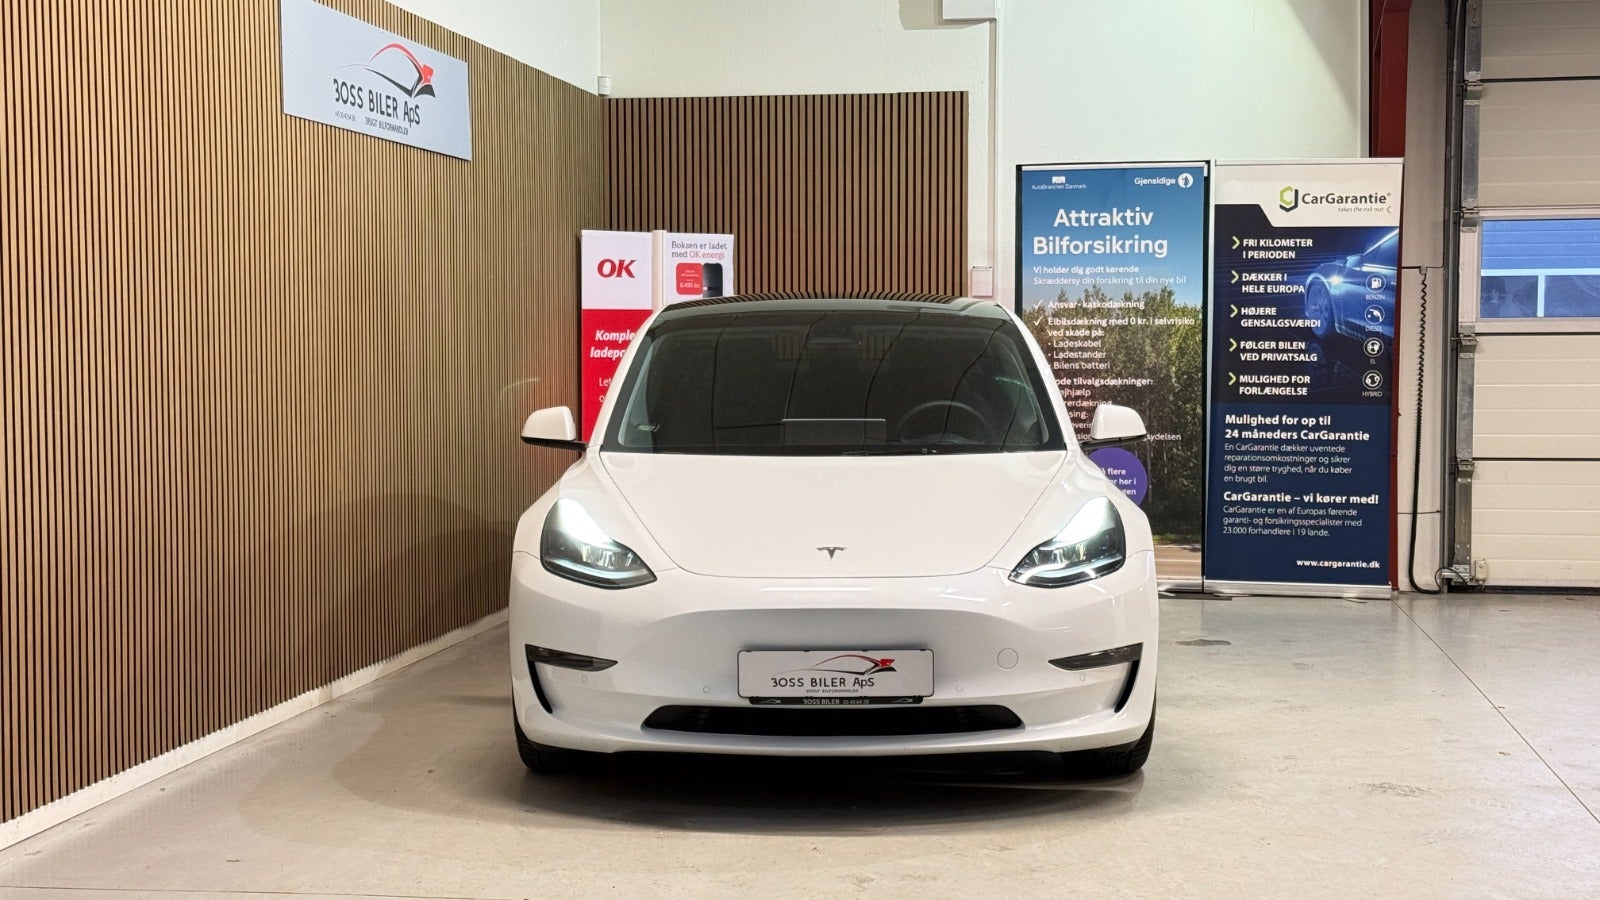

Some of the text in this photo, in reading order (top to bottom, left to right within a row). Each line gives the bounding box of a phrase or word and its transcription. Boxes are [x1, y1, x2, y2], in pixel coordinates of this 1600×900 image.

[368, 89, 399, 119] BILER
[403, 100, 421, 128] ApS
[1134, 176, 1176, 186] Gjensidige
[1053, 206, 1154, 228] Attraktiv
[671, 240, 698, 249] Boksen
[708, 242, 728, 250] ladet
[1033, 234, 1168, 259] Bilforsikring
[1243, 238, 1313, 248] FRI KILOMETER
[702, 251, 725, 261] energi
[1243, 251, 1296, 260] I PERIODEN
[597, 258, 637, 279] OK
[1033, 265, 1139, 276] Vi holder dig godt kørende
[1033, 275, 1186, 287] Skræddersy din forsikring til din nye bil
[1242, 273, 1282, 282] DÆKKER
[1242, 285, 1305, 294] HELE EUROPA
[1048, 300, 1145, 310] Ansvar- kaskodækning
[1241, 307, 1277, 316] HØJERE
[1048, 317, 1107, 327] Elbilsdækning
[1109, 317, 1128, 325] med
[1130, 317, 1136, 325] 0
[1138, 317, 1149, 325] kr.
[1154, 317, 1195, 325] selvrisiko
[1240, 319, 1321, 328] GENSALGSVÆRDI
[595, 329, 635, 344] Komple
[1048, 329, 1105, 339] ved skade på:
[1053, 339, 1101, 348] Ladeskabel
[1240, 341, 1306, 350] FØLGER BILEN
[1053, 350, 1106, 359] Ladestander
[1240, 353, 1318, 363] VED PRIVATSALG
[1053, 361, 1110, 370] Bilens batteri
[1055, 376, 1154, 388] ode tilvalgsdækninger:
[1239, 375, 1311, 384] MULIGHED FOR
[1061, 388, 1091, 397] ejhjælp
[1239, 387, 1308, 396] FORLÆNGELSE
[1069, 410, 1089, 419] sing:
[1225, 414, 1331, 428] Mulighed for op til
[1143, 432, 1182, 443] sydelsen
[1225, 428, 1370, 441] 24 måneders CarGarantie
[1224, 443, 1346, 453] En CarGarantie dækker uventede
[1224, 454, 1317, 464] reparationsomkostninger
[1330, 455, 1351, 464] sikrer
[1107, 467, 1127, 475] flere
[1224, 465, 1236, 474] dig
[1249, 465, 1271, 473] større
[1272, 465, 1303, 475] tryghed,
[1304, 465, 1317, 474] når
[1318, 466, 1329, 474] du
[1330, 466, 1352, 474] køber
[1235, 475, 1256, 484] brugt
[1257, 475, 1269, 483] bil.
[1223, 491, 1292, 502] CarGarantie
[1303, 493, 1314, 503] vi
[1316, 493, 1347, 504] kører
[1349, 494, 1379, 505] med!
[1223, 505, 1266, 514] CarGarantie
[1288, 506, 1296, 515] af
[1296, 507, 1327, 516] Europas
[1328, 507, 1358, 516] førende
[1223, 516, 1363, 527] garanti- og forsikringsspecialister med
[1223, 527, 1247, 535] 23.000
[1248, 527, 1291, 535] forhandlere
[1297, 528, 1306, 536] 19
[1307, 528, 1330, 537] lande.
[1296, 558, 1381, 569] www.cargarantie.dk
[810, 677, 846, 688] BILER
[853, 677, 875, 689] ApS
